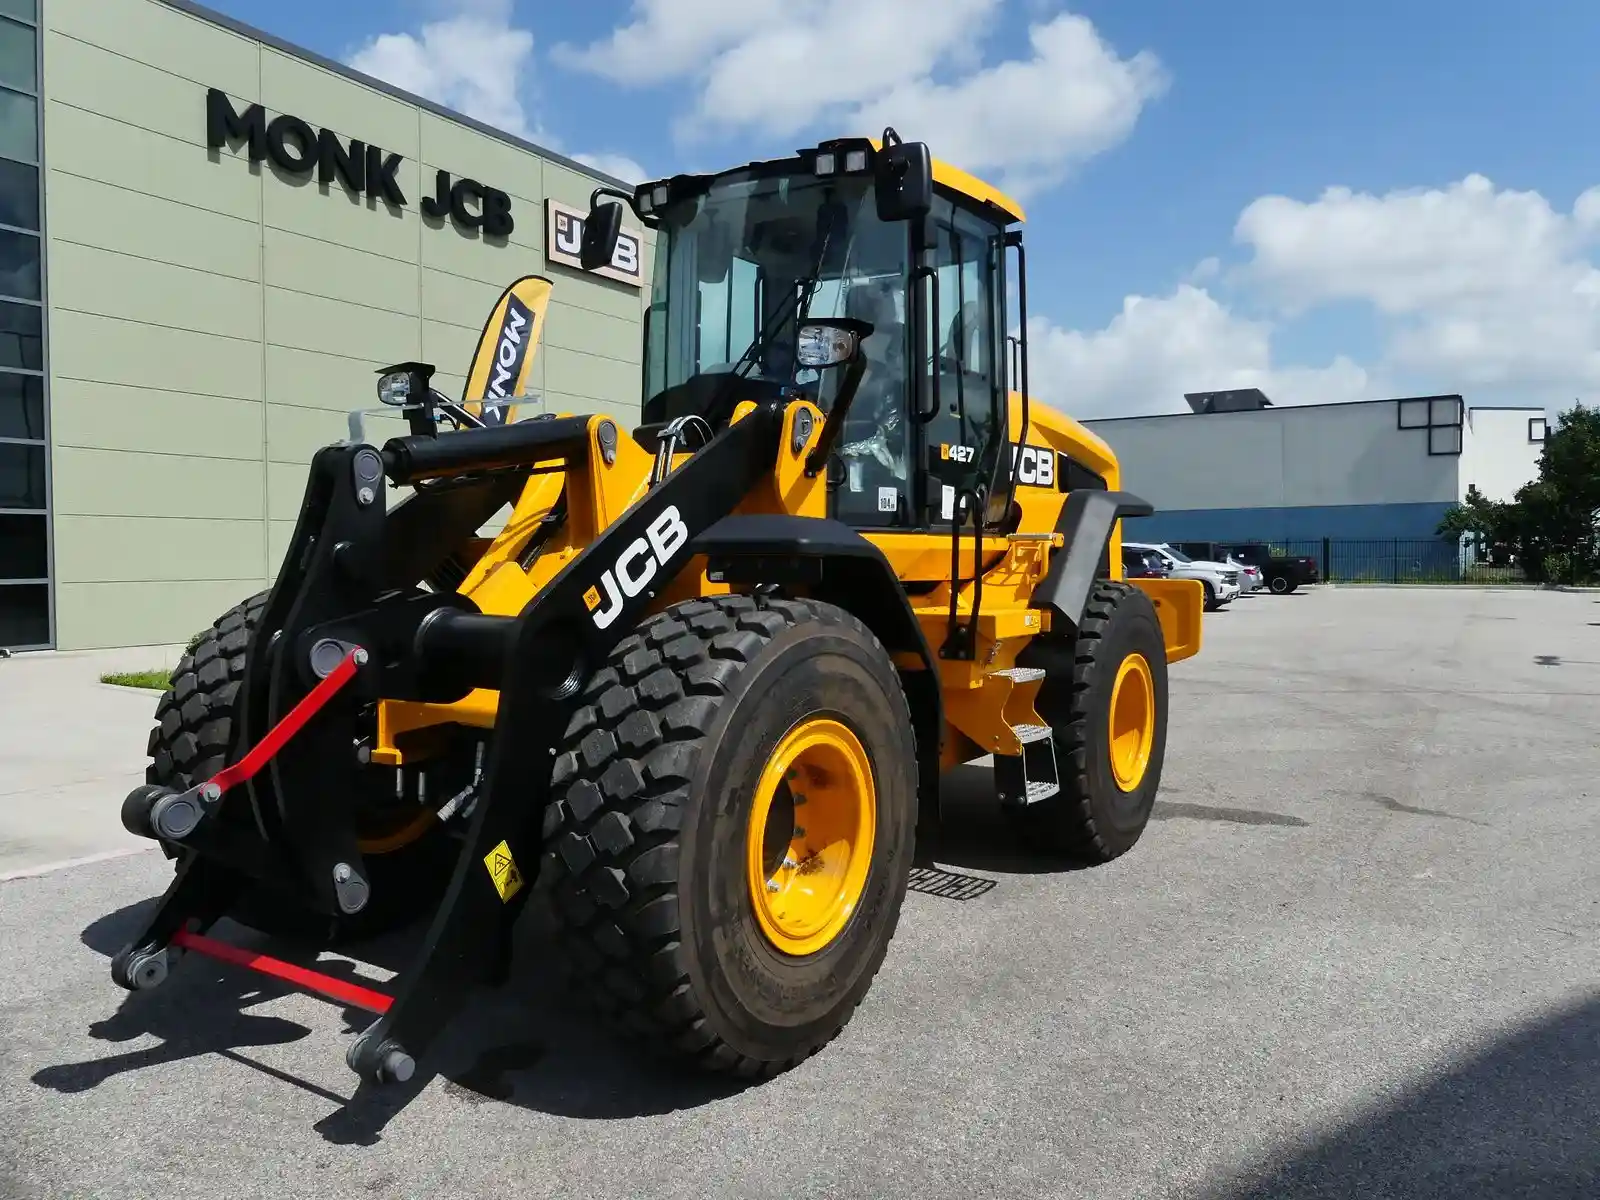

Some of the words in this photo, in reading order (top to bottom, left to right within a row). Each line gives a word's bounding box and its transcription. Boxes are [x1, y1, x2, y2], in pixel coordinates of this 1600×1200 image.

[206, 87, 408, 205] MONK
[420, 169, 514, 235] JCB
[557, 219, 638, 272] JB
[485, 307, 526, 421] MONK
[949, 444, 975, 463] 427
[592, 505, 688, 629] JCB
